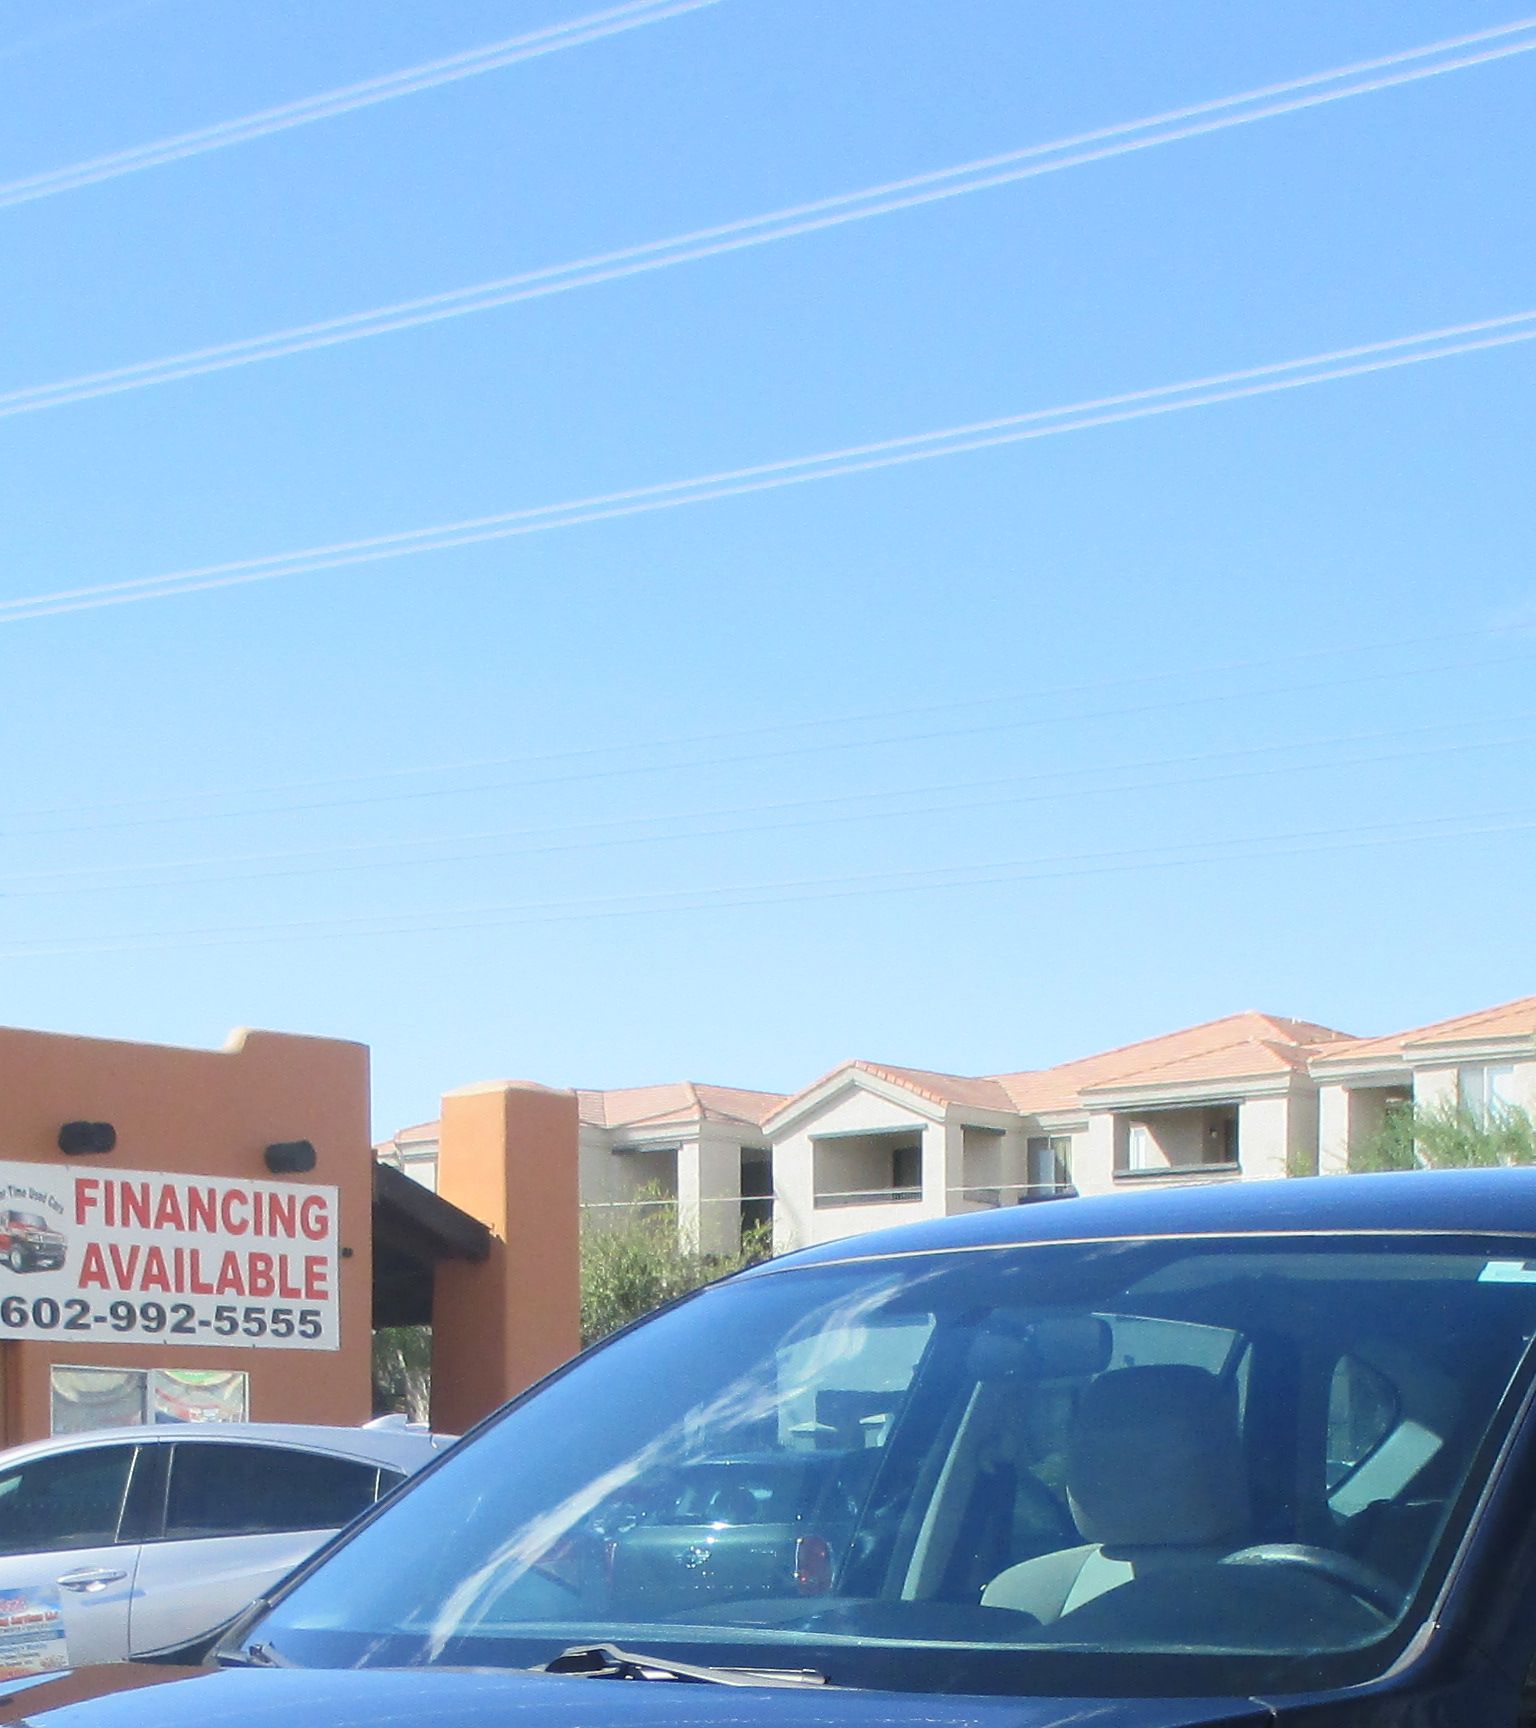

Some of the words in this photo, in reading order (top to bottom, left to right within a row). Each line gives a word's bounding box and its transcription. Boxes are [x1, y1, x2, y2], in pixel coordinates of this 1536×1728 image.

[75, 1178, 329, 1241] FINANCING
[78, 1243, 329, 1300] AVAILABLE
[0, 1296, 323, 1339] 602-992-5555
